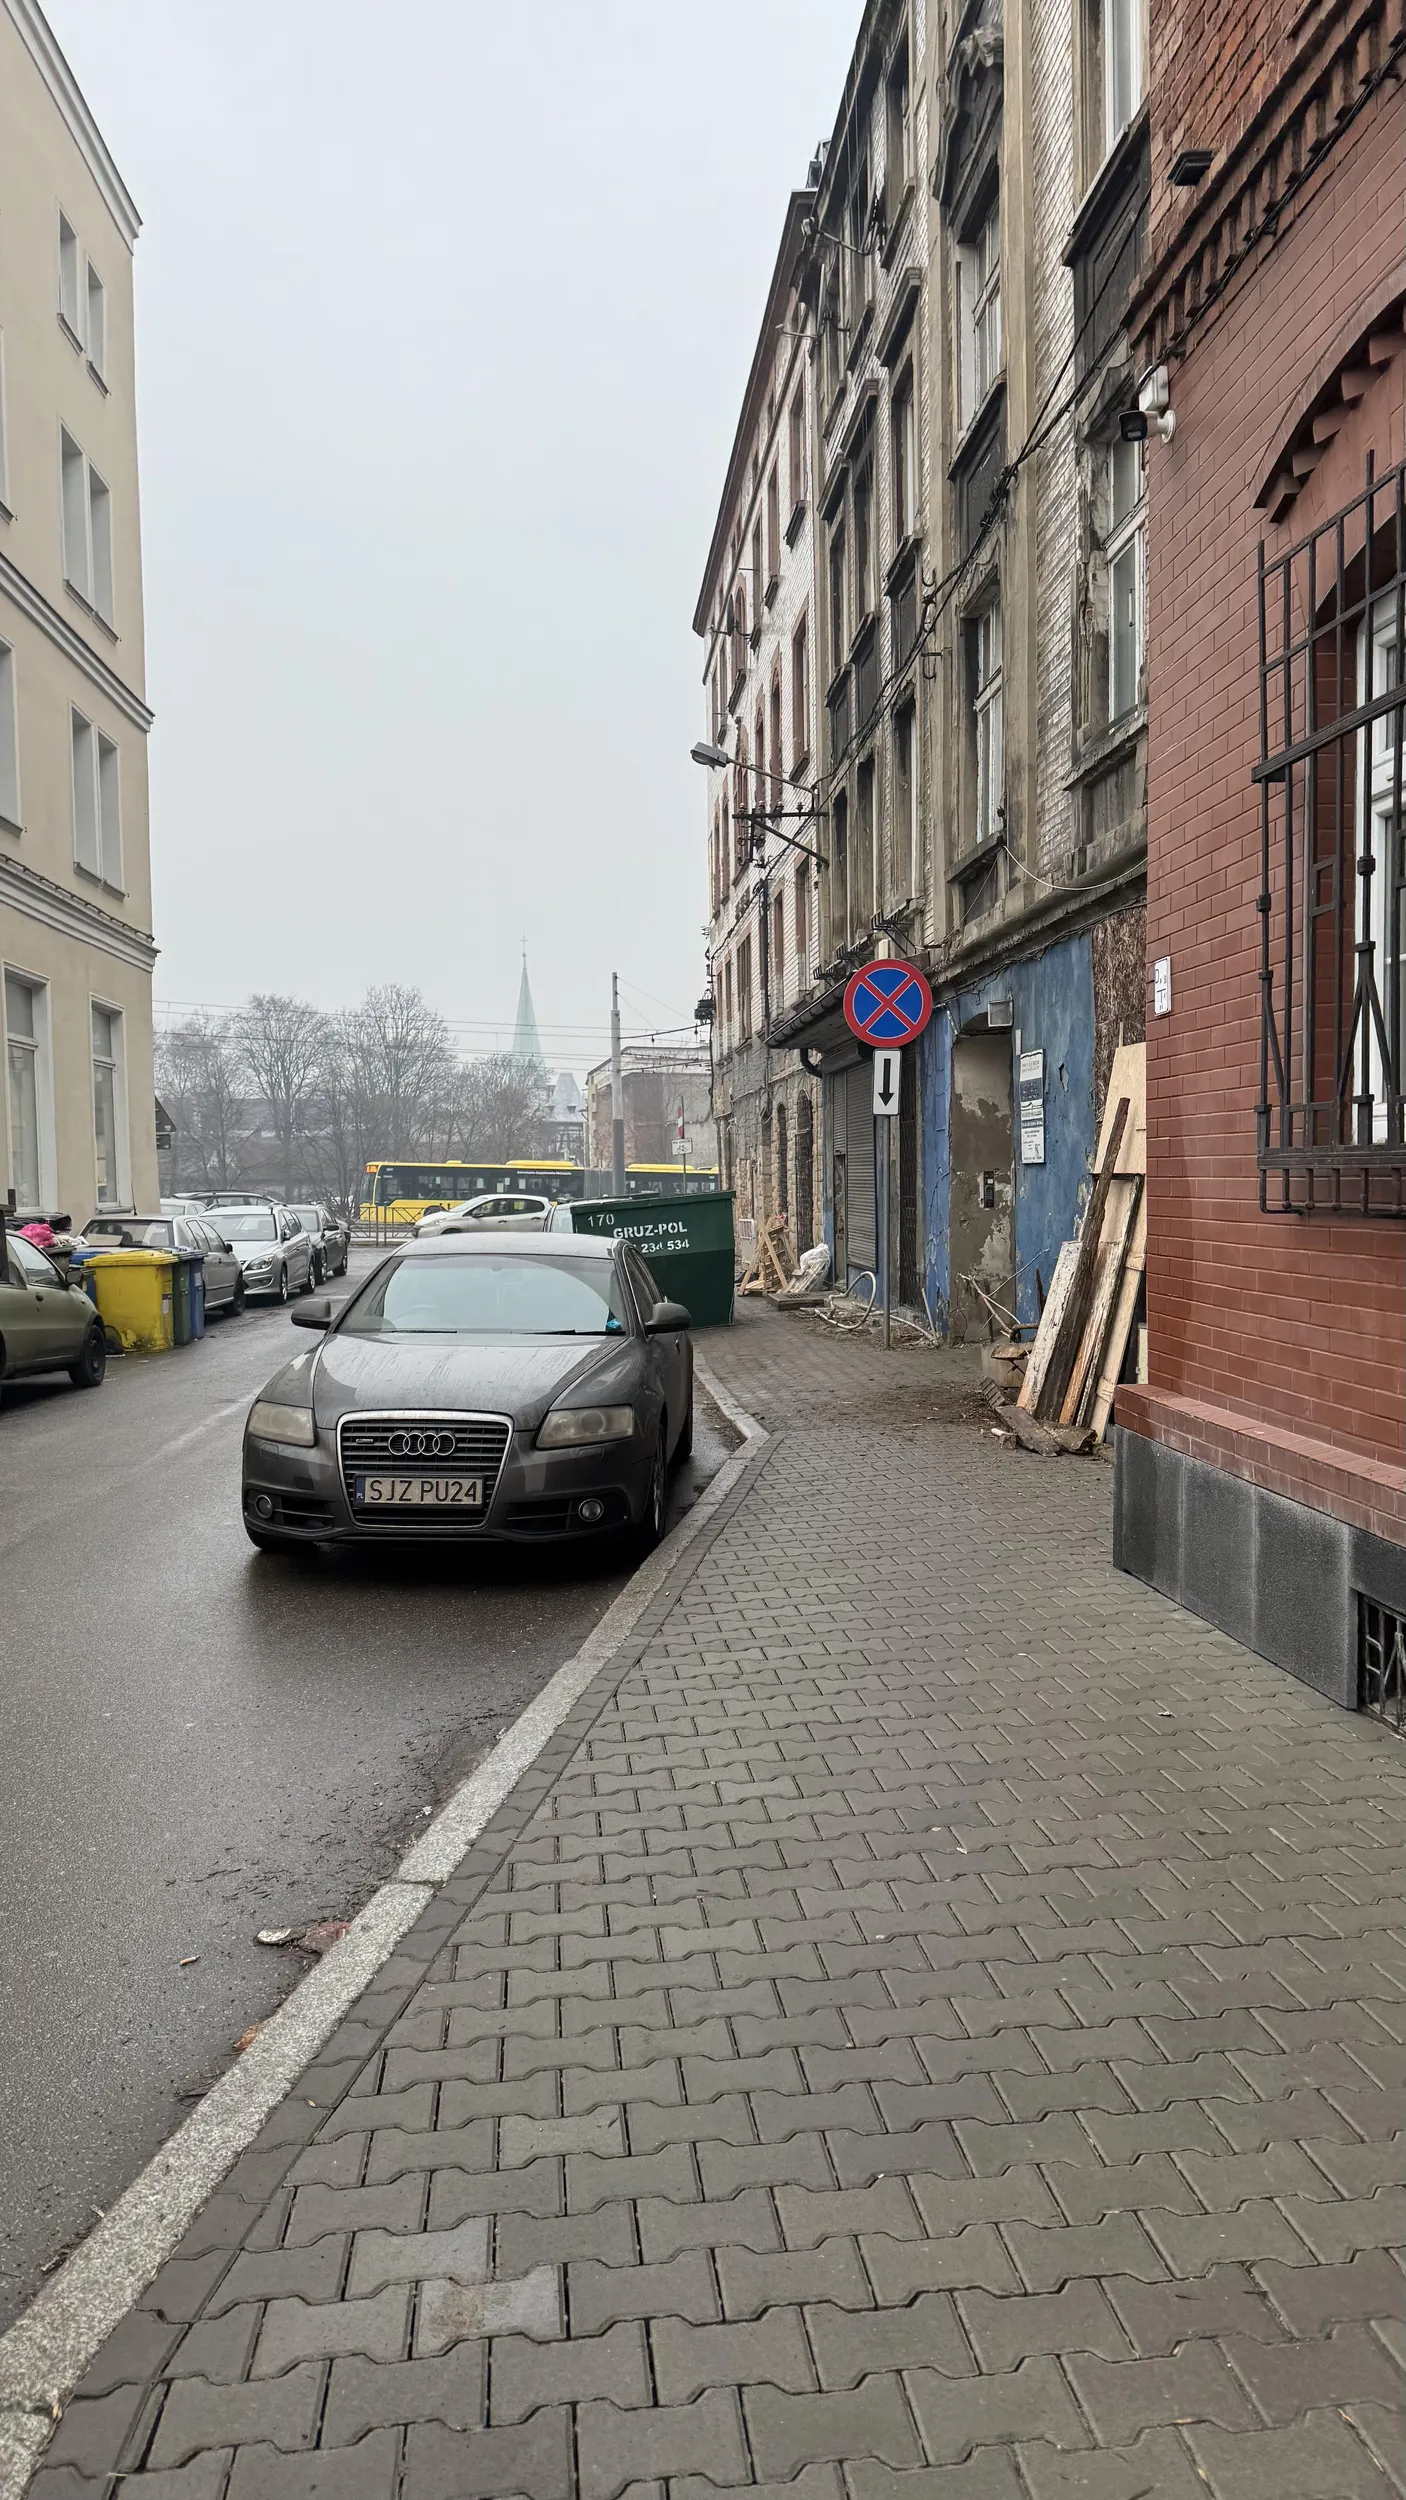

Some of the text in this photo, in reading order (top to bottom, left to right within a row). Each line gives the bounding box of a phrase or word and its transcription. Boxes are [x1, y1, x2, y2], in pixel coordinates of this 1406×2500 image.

[588, 1213, 615, 1228] 170
[613, 1221, 688, 1239] GRUZ-POL
[641, 1242, 664, 1253] 234
[667, 1239, 690, 1250] 534
[369, 1480, 478, 1502] SJZ PU24
